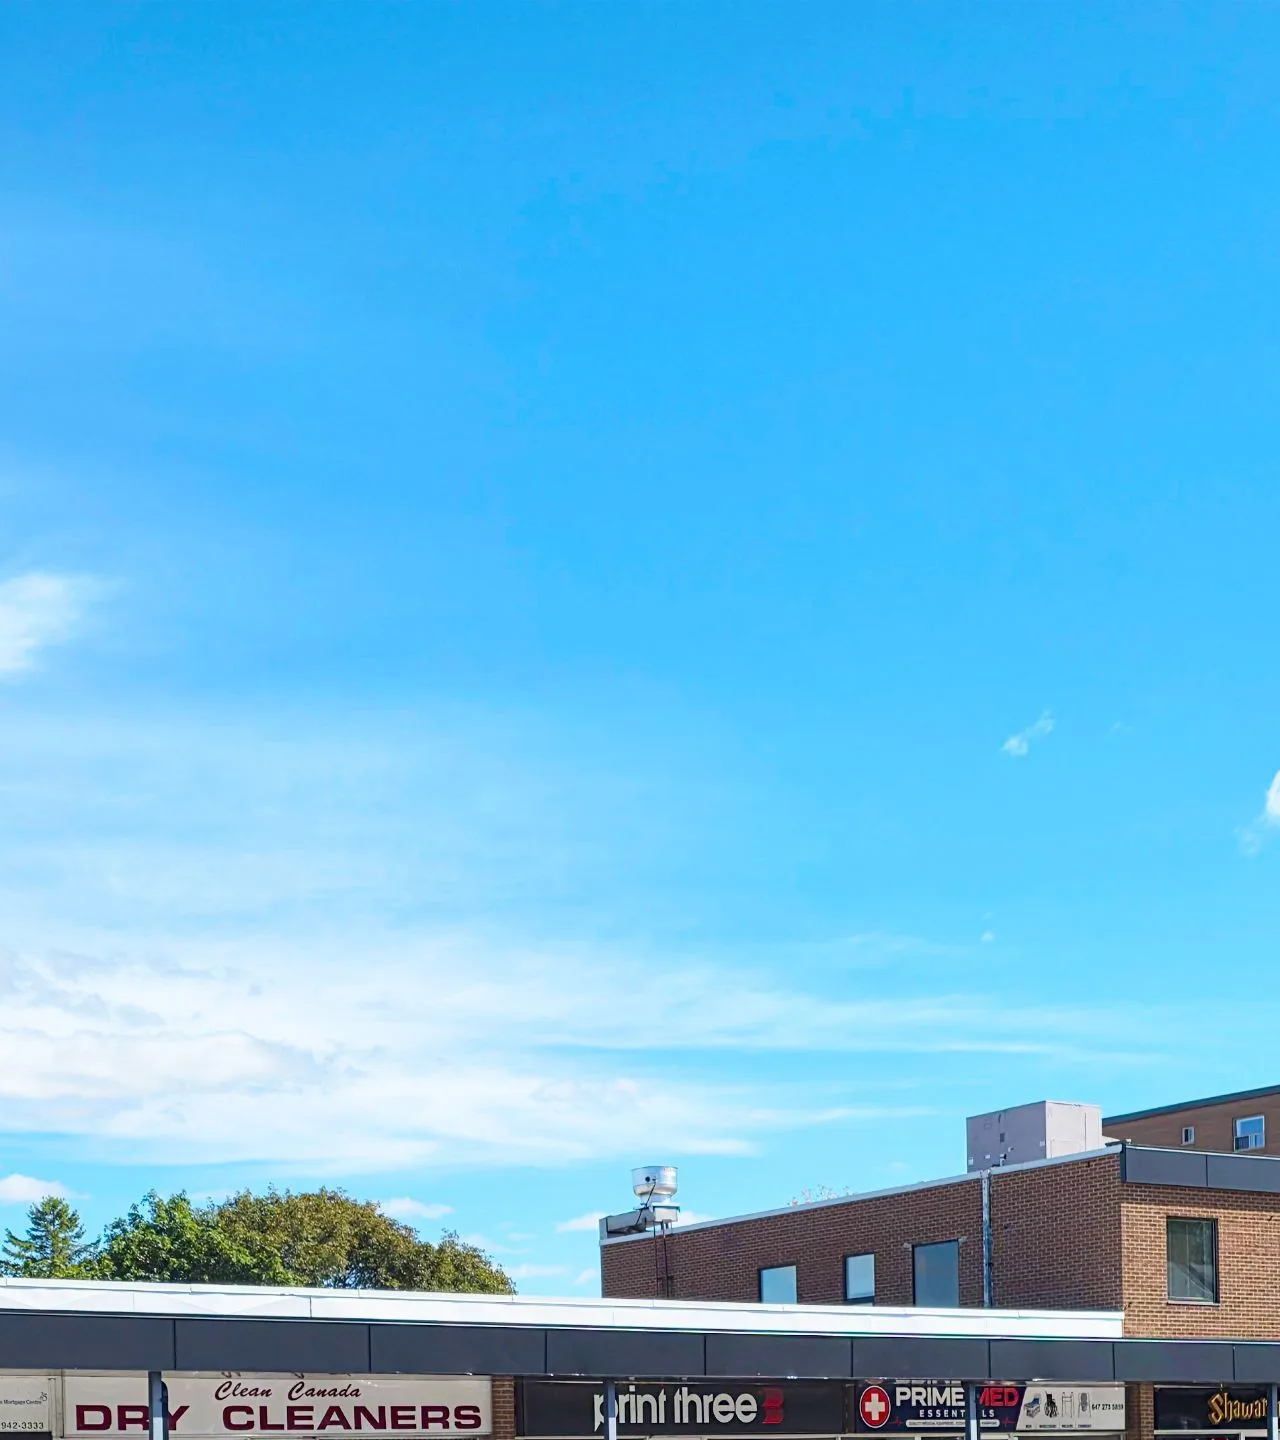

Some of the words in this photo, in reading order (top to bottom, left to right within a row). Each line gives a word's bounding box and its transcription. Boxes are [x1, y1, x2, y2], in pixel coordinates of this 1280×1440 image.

[214, 1380, 272, 1401] Clean
[287, 1380, 362, 1401] Canada
[895, 1387, 964, 1407] PRIME
[673, 1386, 758, 1424] three
[919, 1409, 995, 1418] ESSENTLS
[75, 1404, 190, 1431] DRY
[222, 1404, 482, 1431] CLEANERS
